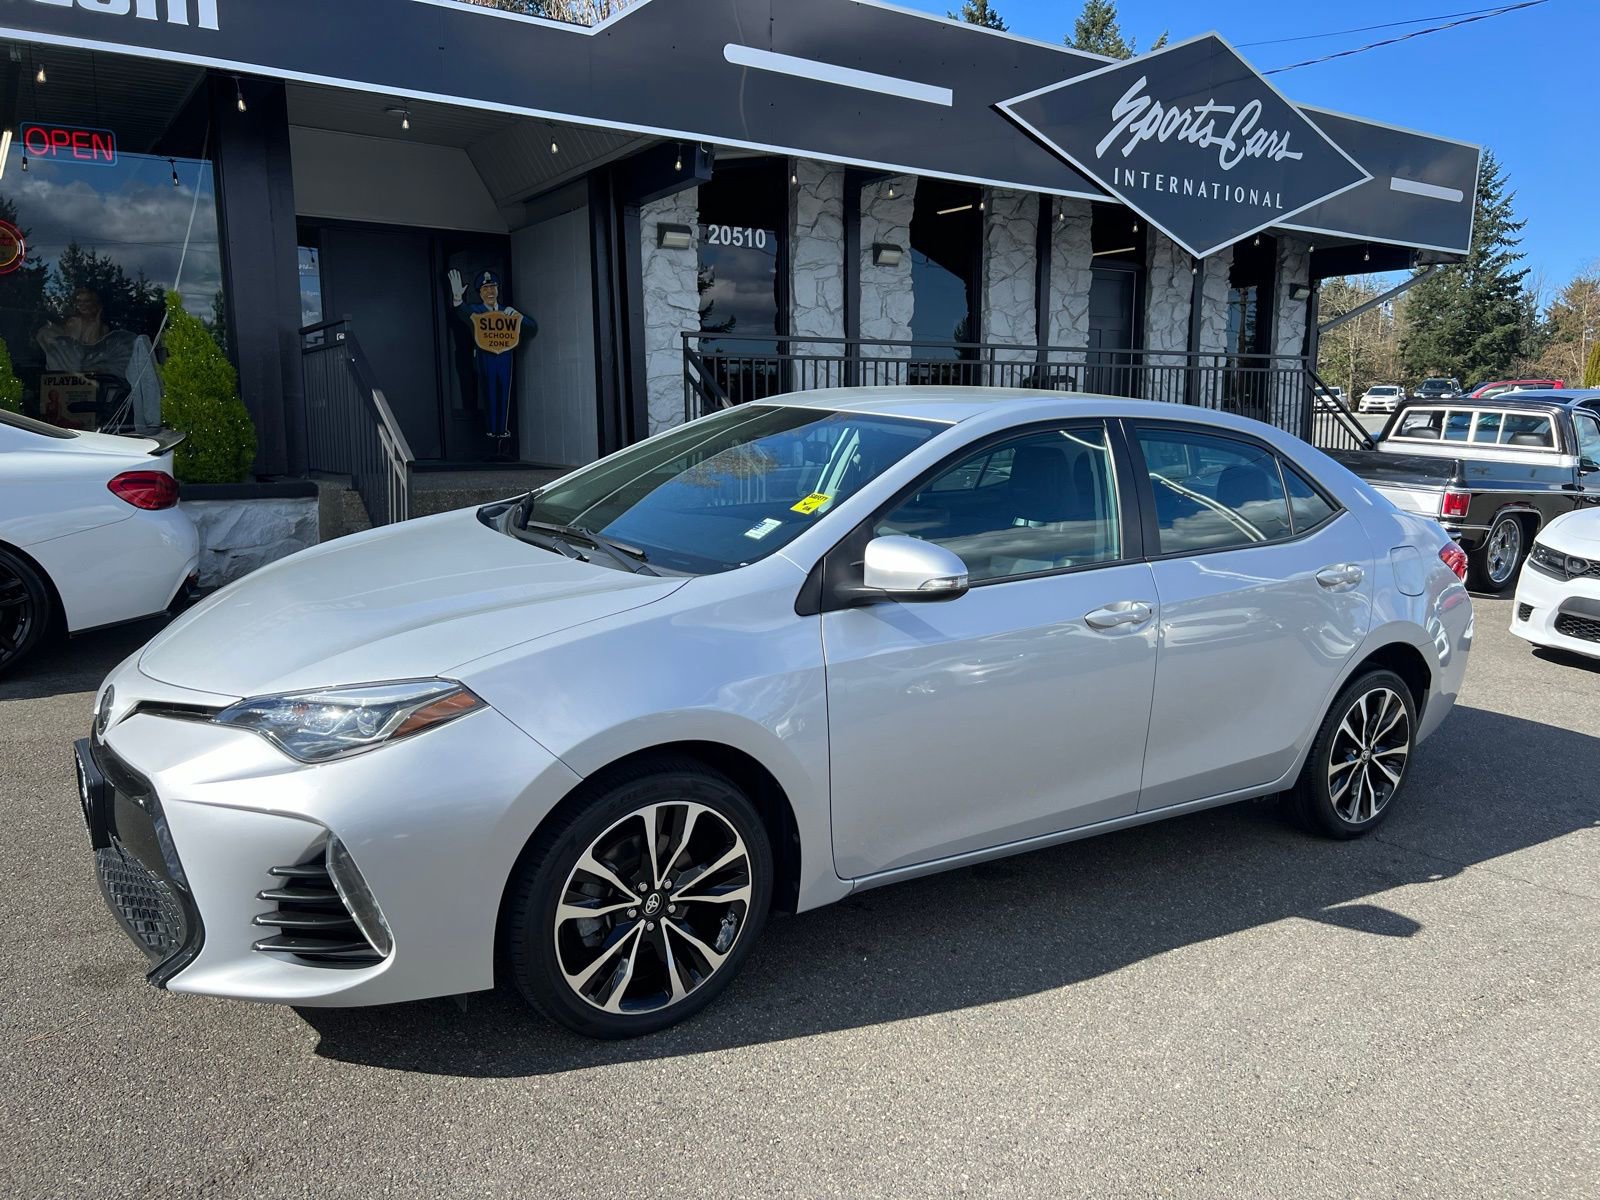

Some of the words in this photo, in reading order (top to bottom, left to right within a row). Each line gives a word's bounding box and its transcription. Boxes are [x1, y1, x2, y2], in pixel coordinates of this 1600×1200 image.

[1096, 76, 1235, 158] Sports
[1219, 99, 1303, 170] Cars
[25, 127, 113, 161] OPEN
[1114, 167, 1284, 209] INTERNATIONAL
[708, 224, 767, 249] 20510
[479, 318, 517, 331] SLOW
[47, 375, 92, 386] PLAYBO
